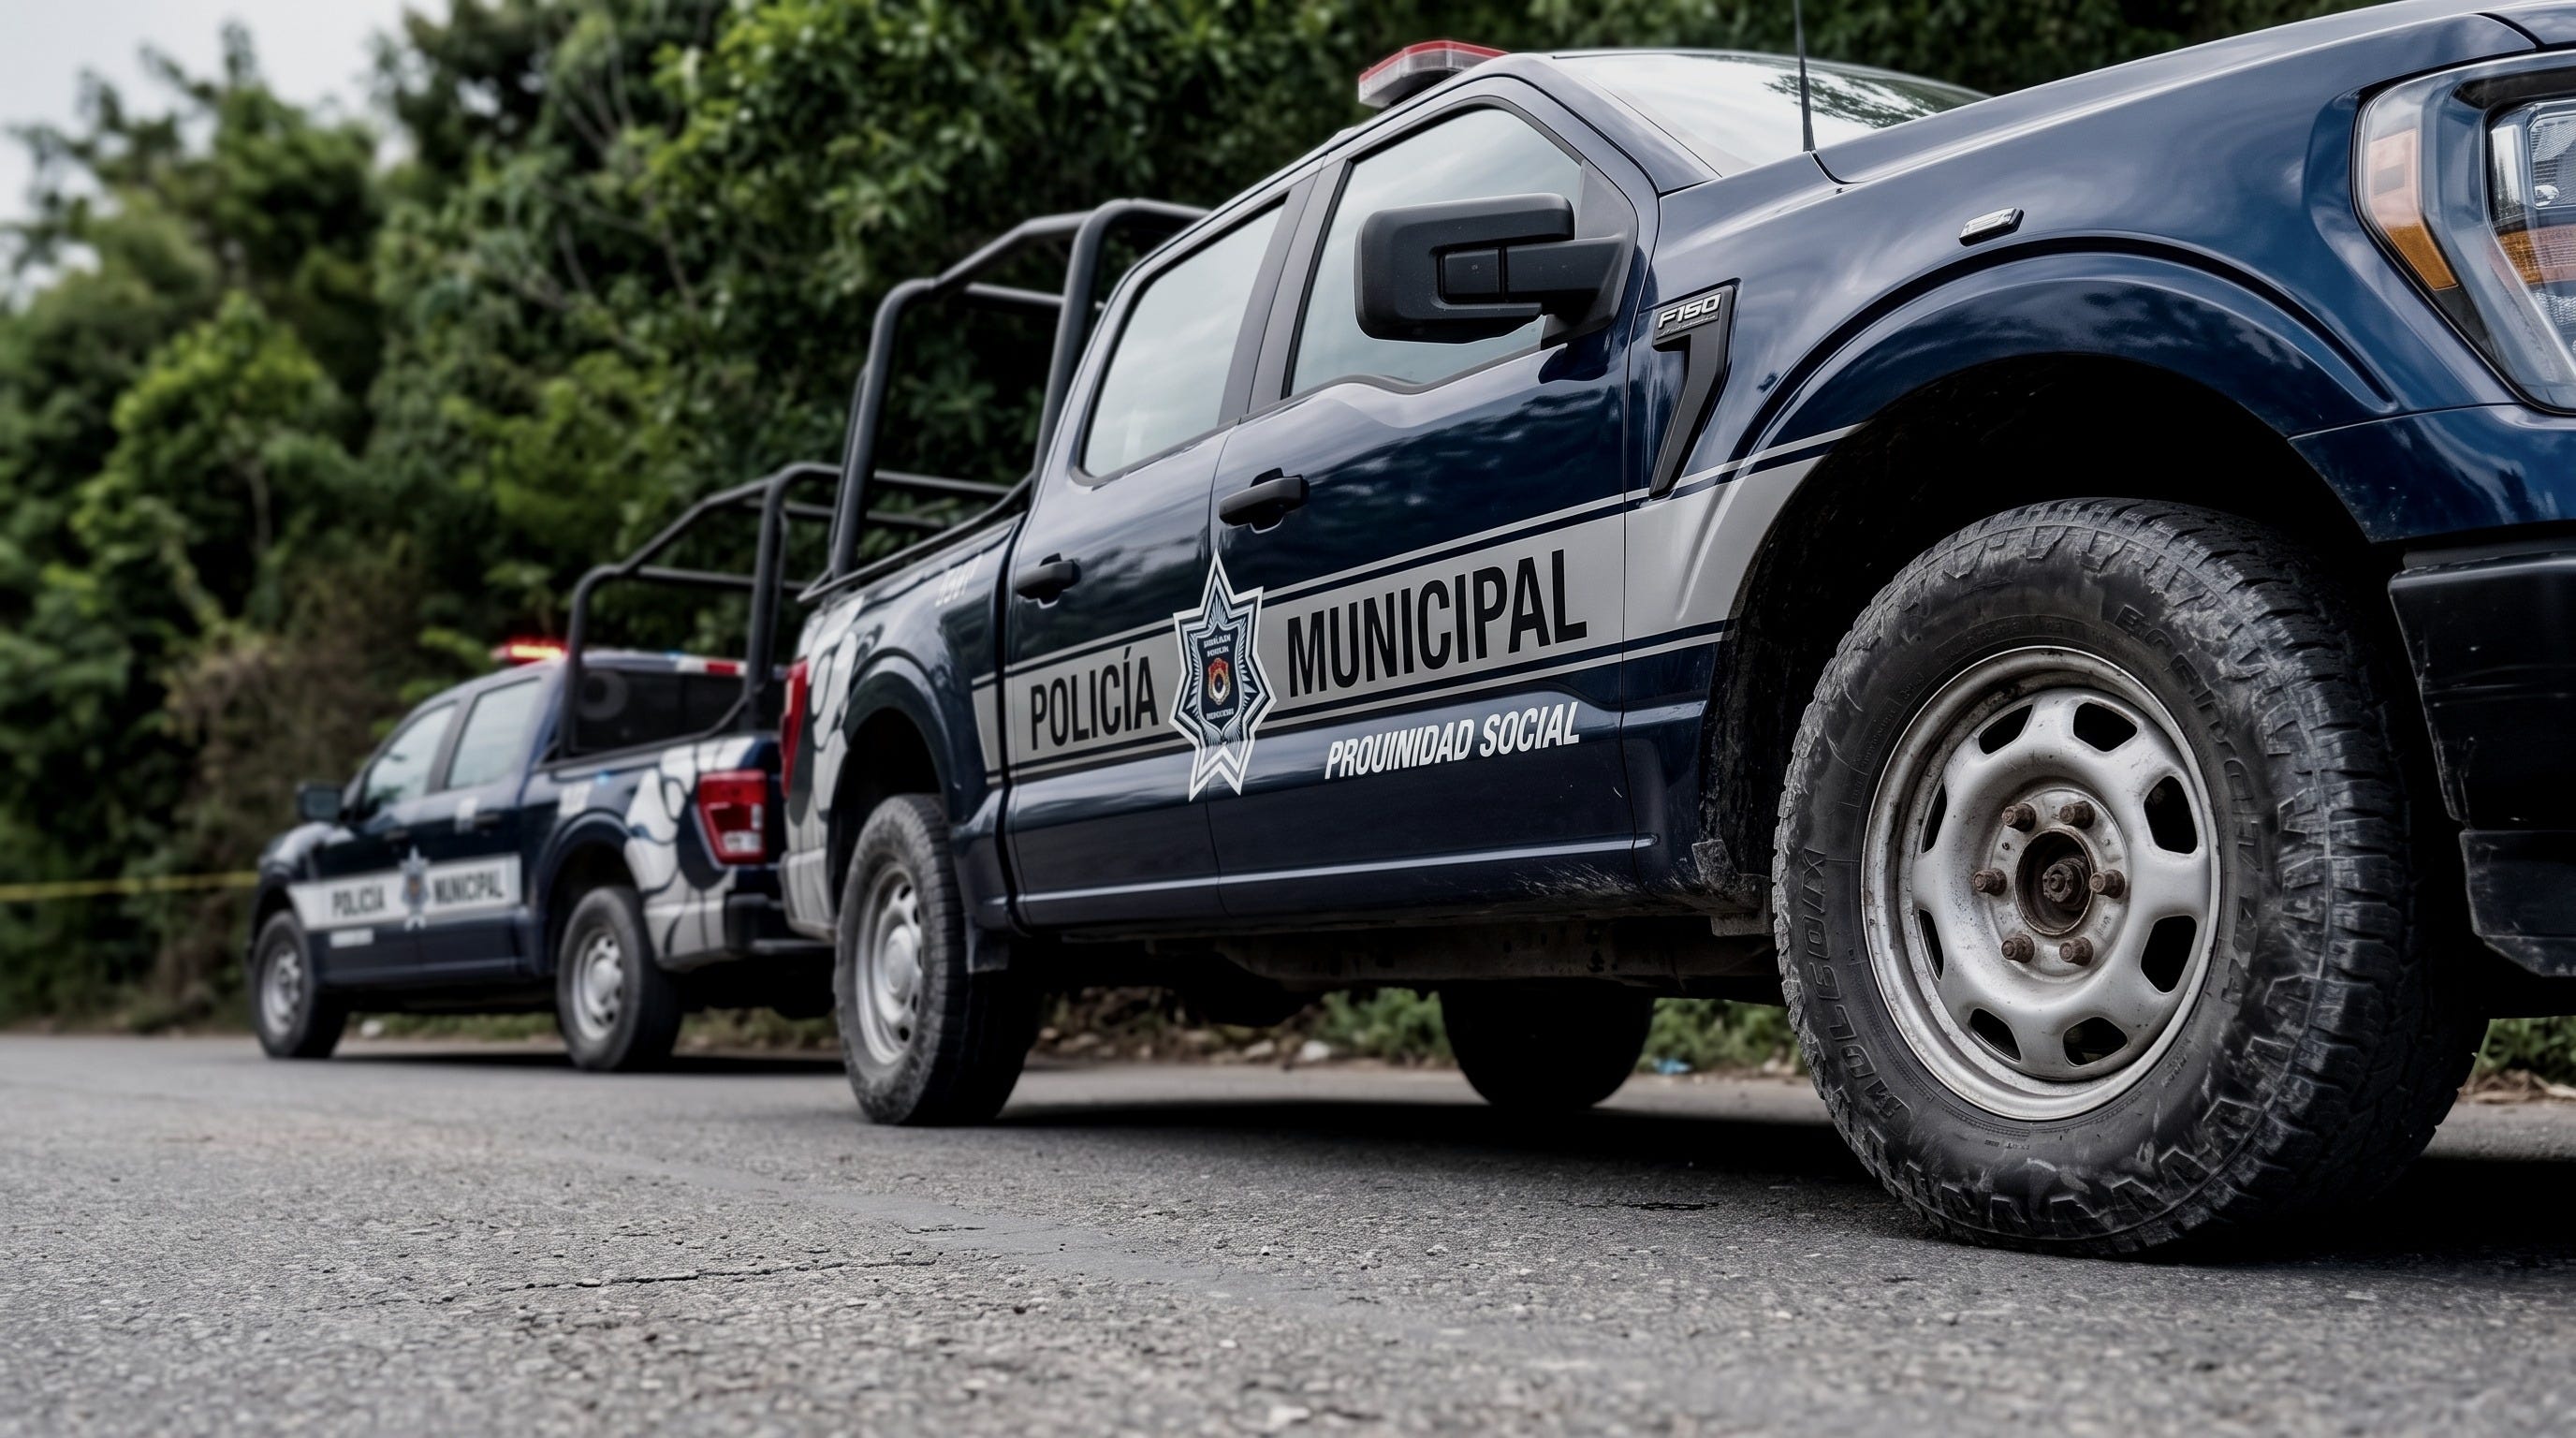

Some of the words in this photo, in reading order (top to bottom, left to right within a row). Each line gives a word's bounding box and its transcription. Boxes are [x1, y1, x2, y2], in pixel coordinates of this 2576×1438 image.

[1658, 293, 1721, 329] F150
[1031, 646, 1159, 751] POLICÍA
[1287, 549, 1588, 697] MUNICIPAL
[1325, 719, 1475, 779] PROUINIDAD
[1479, 701, 1580, 757] SOCIAL
